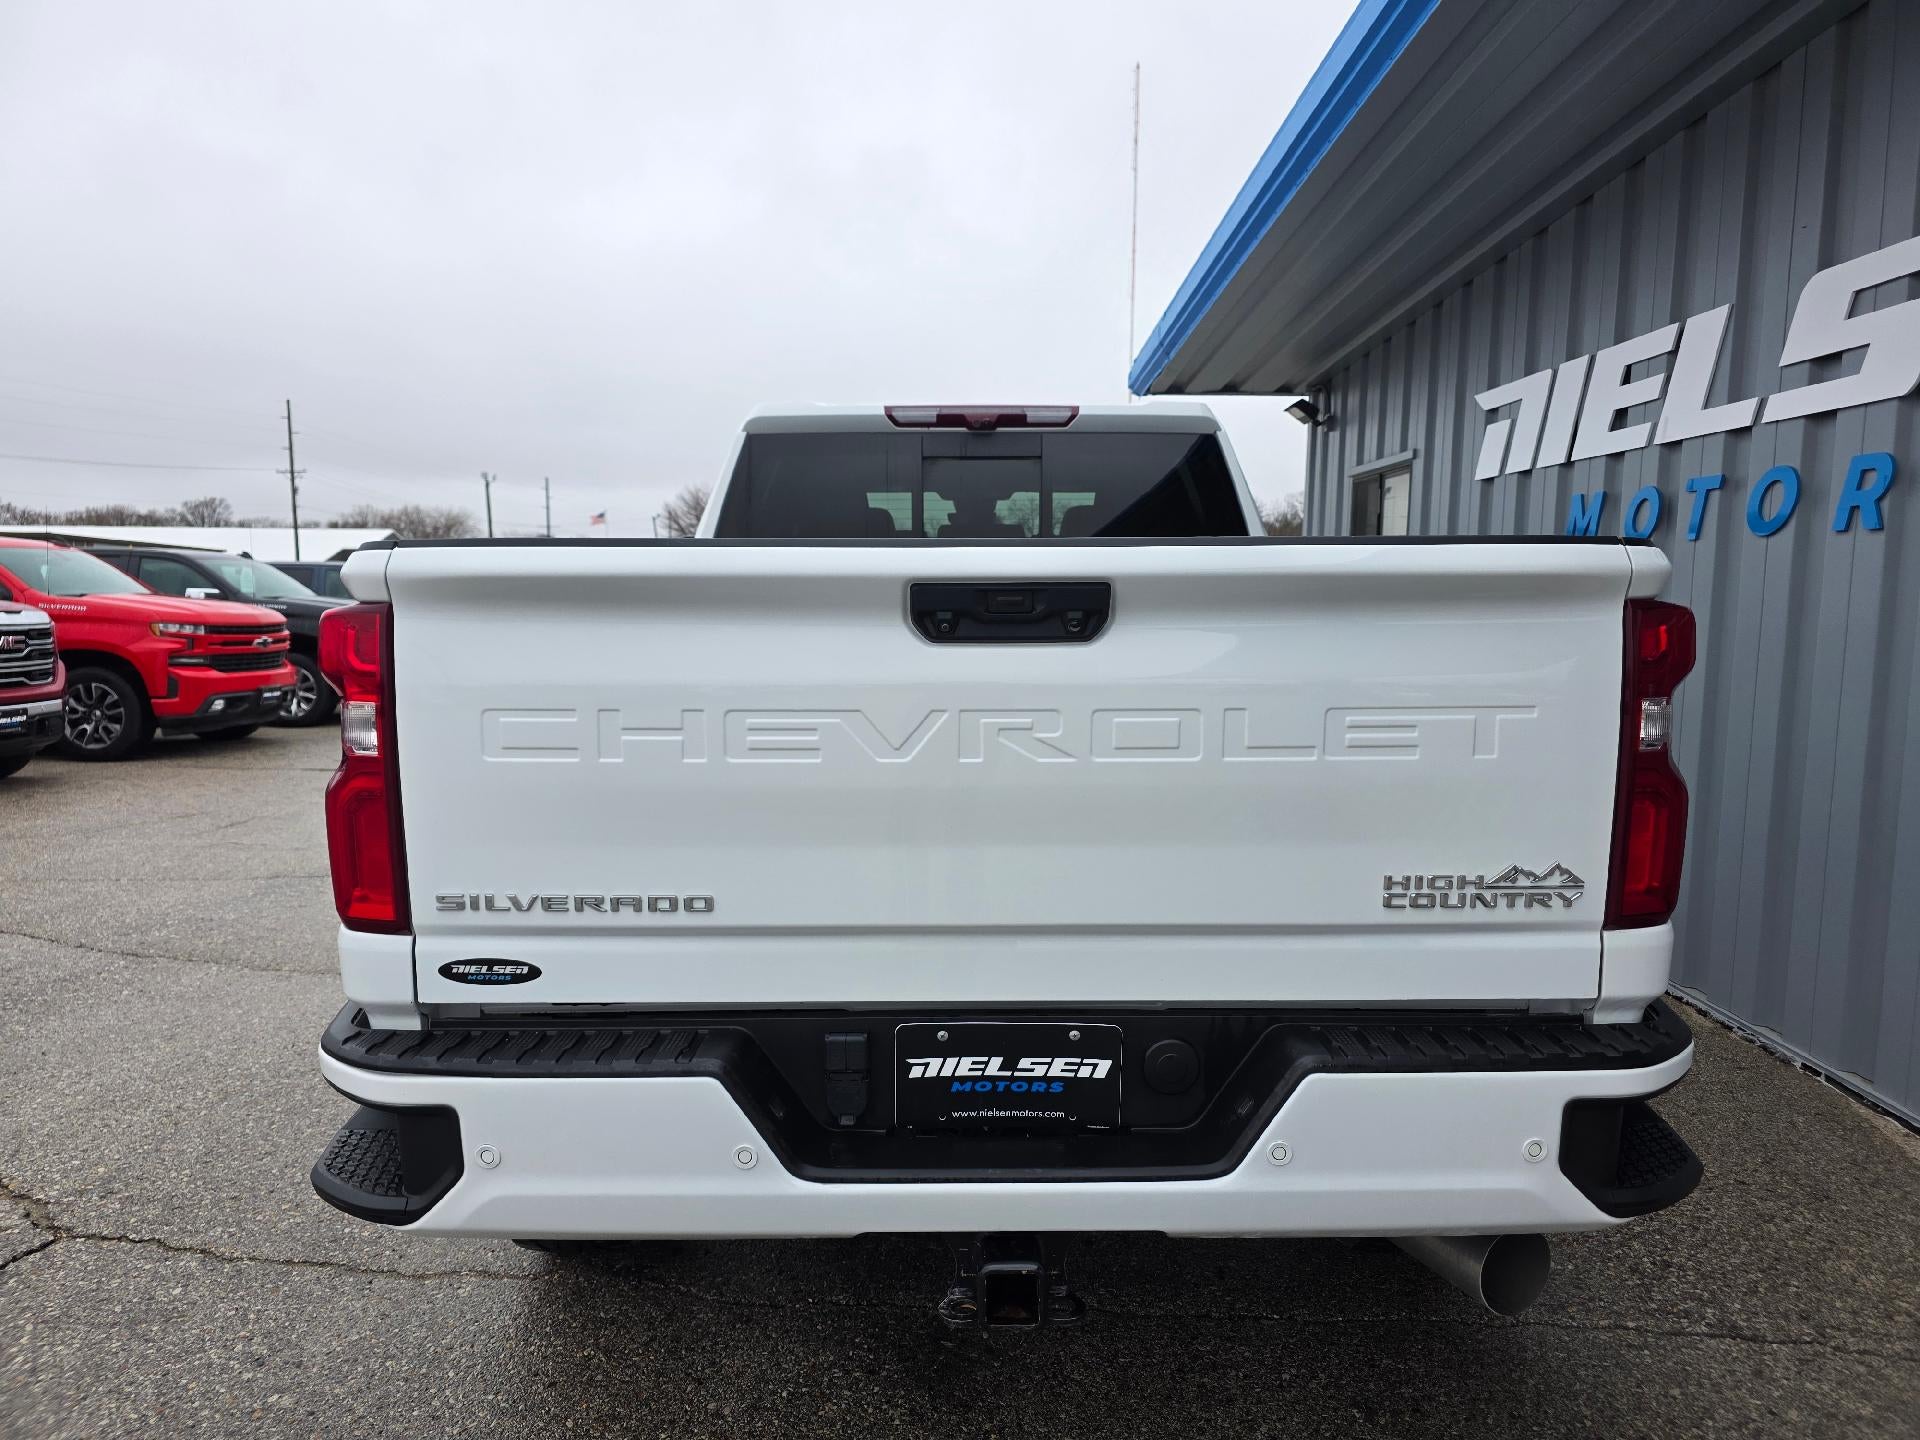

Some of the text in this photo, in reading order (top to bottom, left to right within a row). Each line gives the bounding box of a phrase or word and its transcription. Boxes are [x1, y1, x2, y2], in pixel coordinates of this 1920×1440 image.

[1566, 452, 1897, 541] MOTOR
[481, 705, 1538, 763] CHEVROLET
[1383, 874, 1485, 890] HIGH
[435, 894, 715, 913] SILVERADO
[1382, 892, 1584, 909] COUNTRY
[450, 964, 529, 975] NIELSEN
[467, 974, 512, 982] MOTORS
[905, 1056, 1113, 1079] NIELSEN
[951, 1081, 1065, 1094] MOTORS
[951, 1108, 1066, 1119] www.nielsenmotors.com
